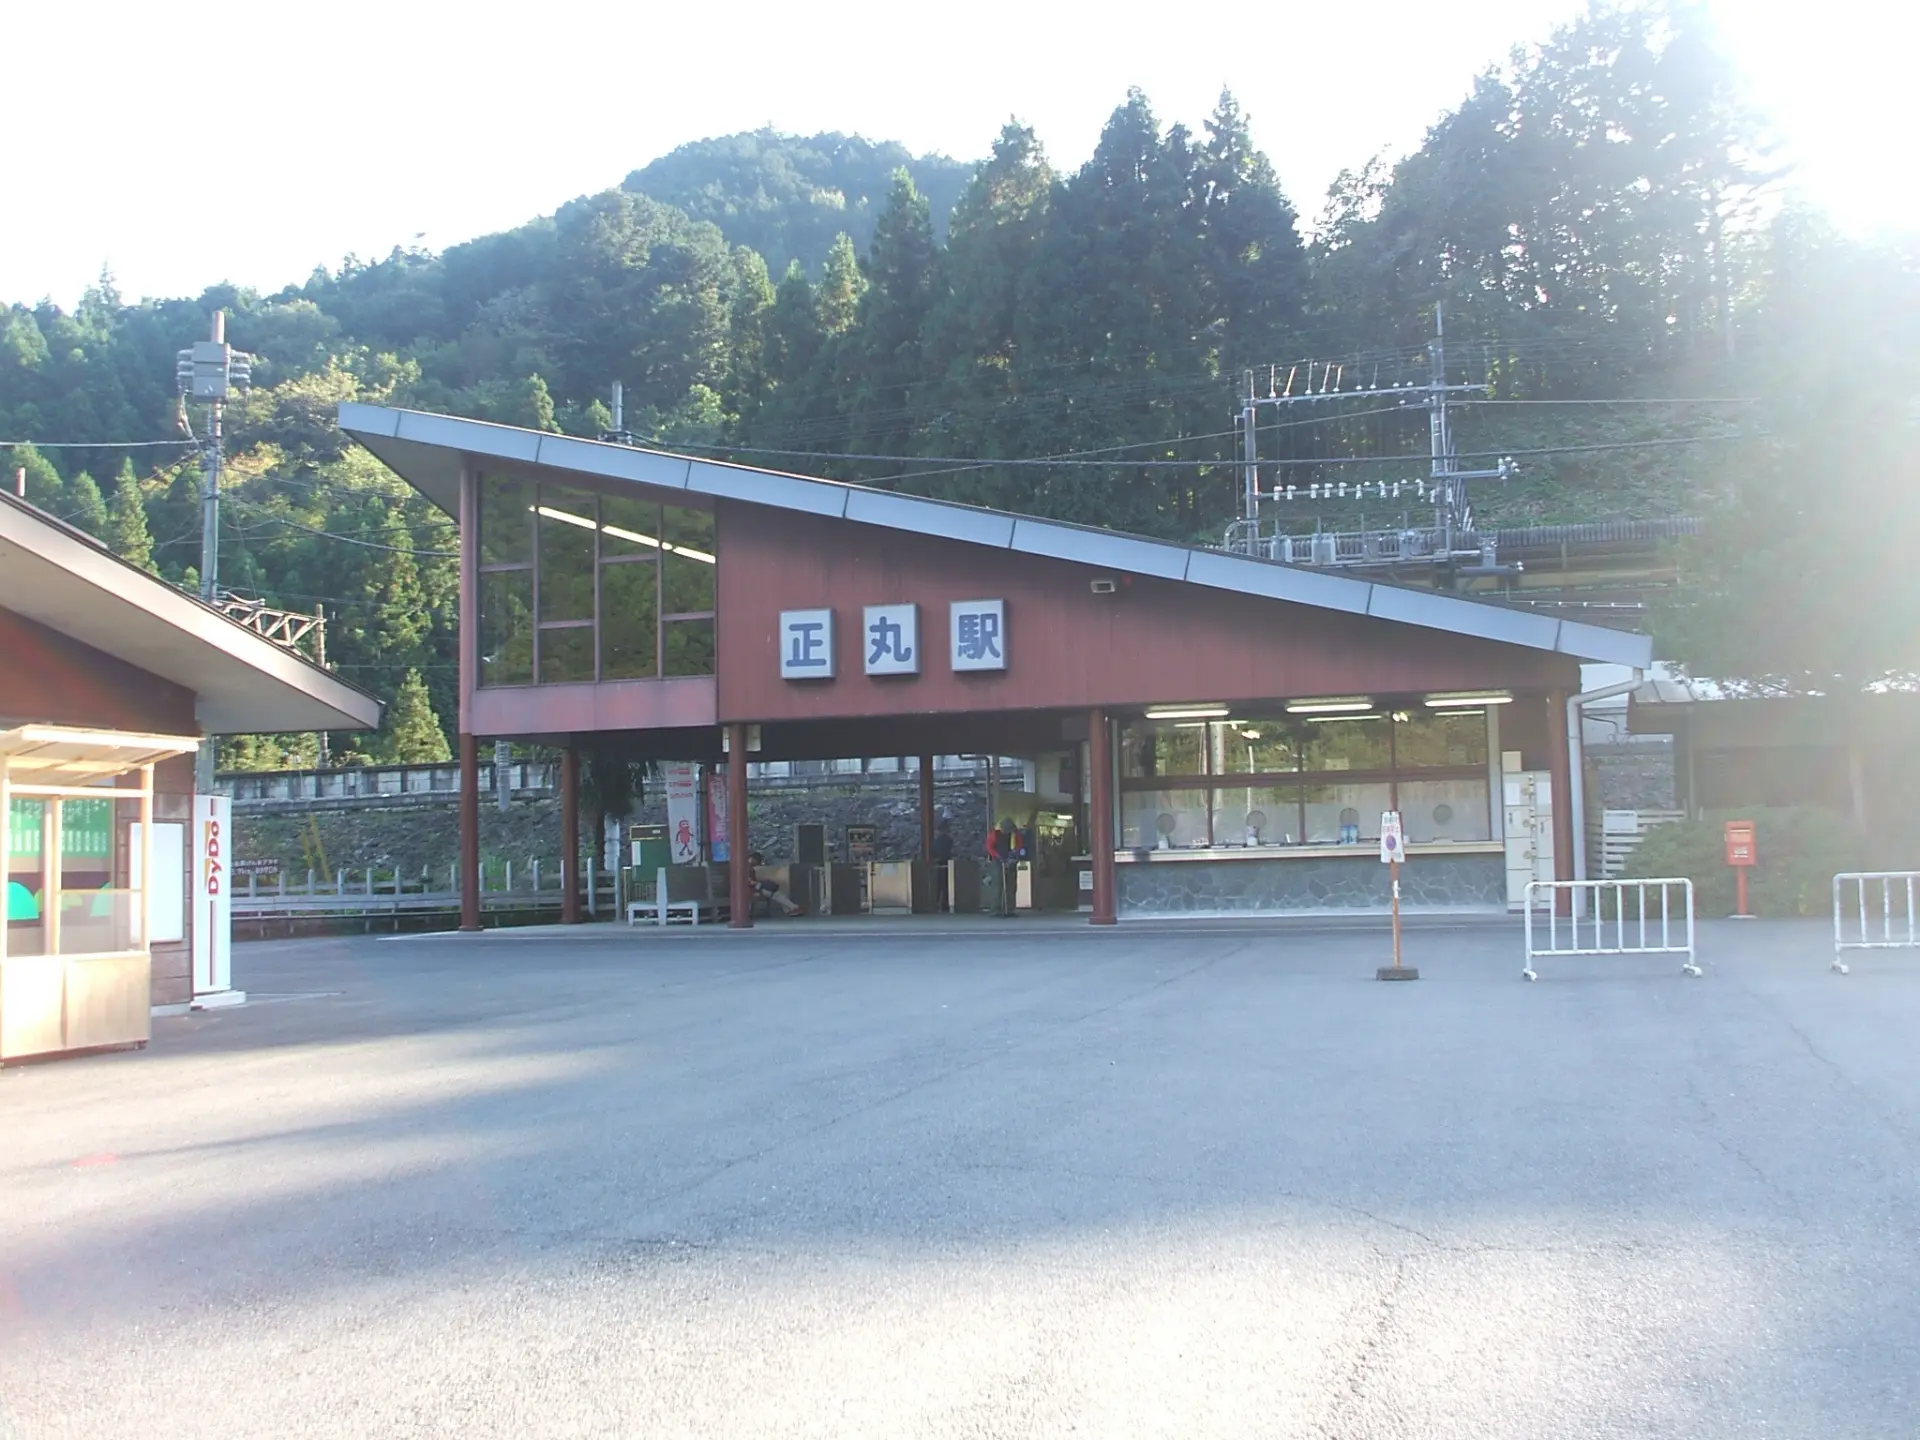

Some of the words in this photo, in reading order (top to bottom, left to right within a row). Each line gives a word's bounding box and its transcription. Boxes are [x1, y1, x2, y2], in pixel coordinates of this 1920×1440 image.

[786, 613, 1001, 667] 正丸駅
[208, 820, 222, 895] DyDo
